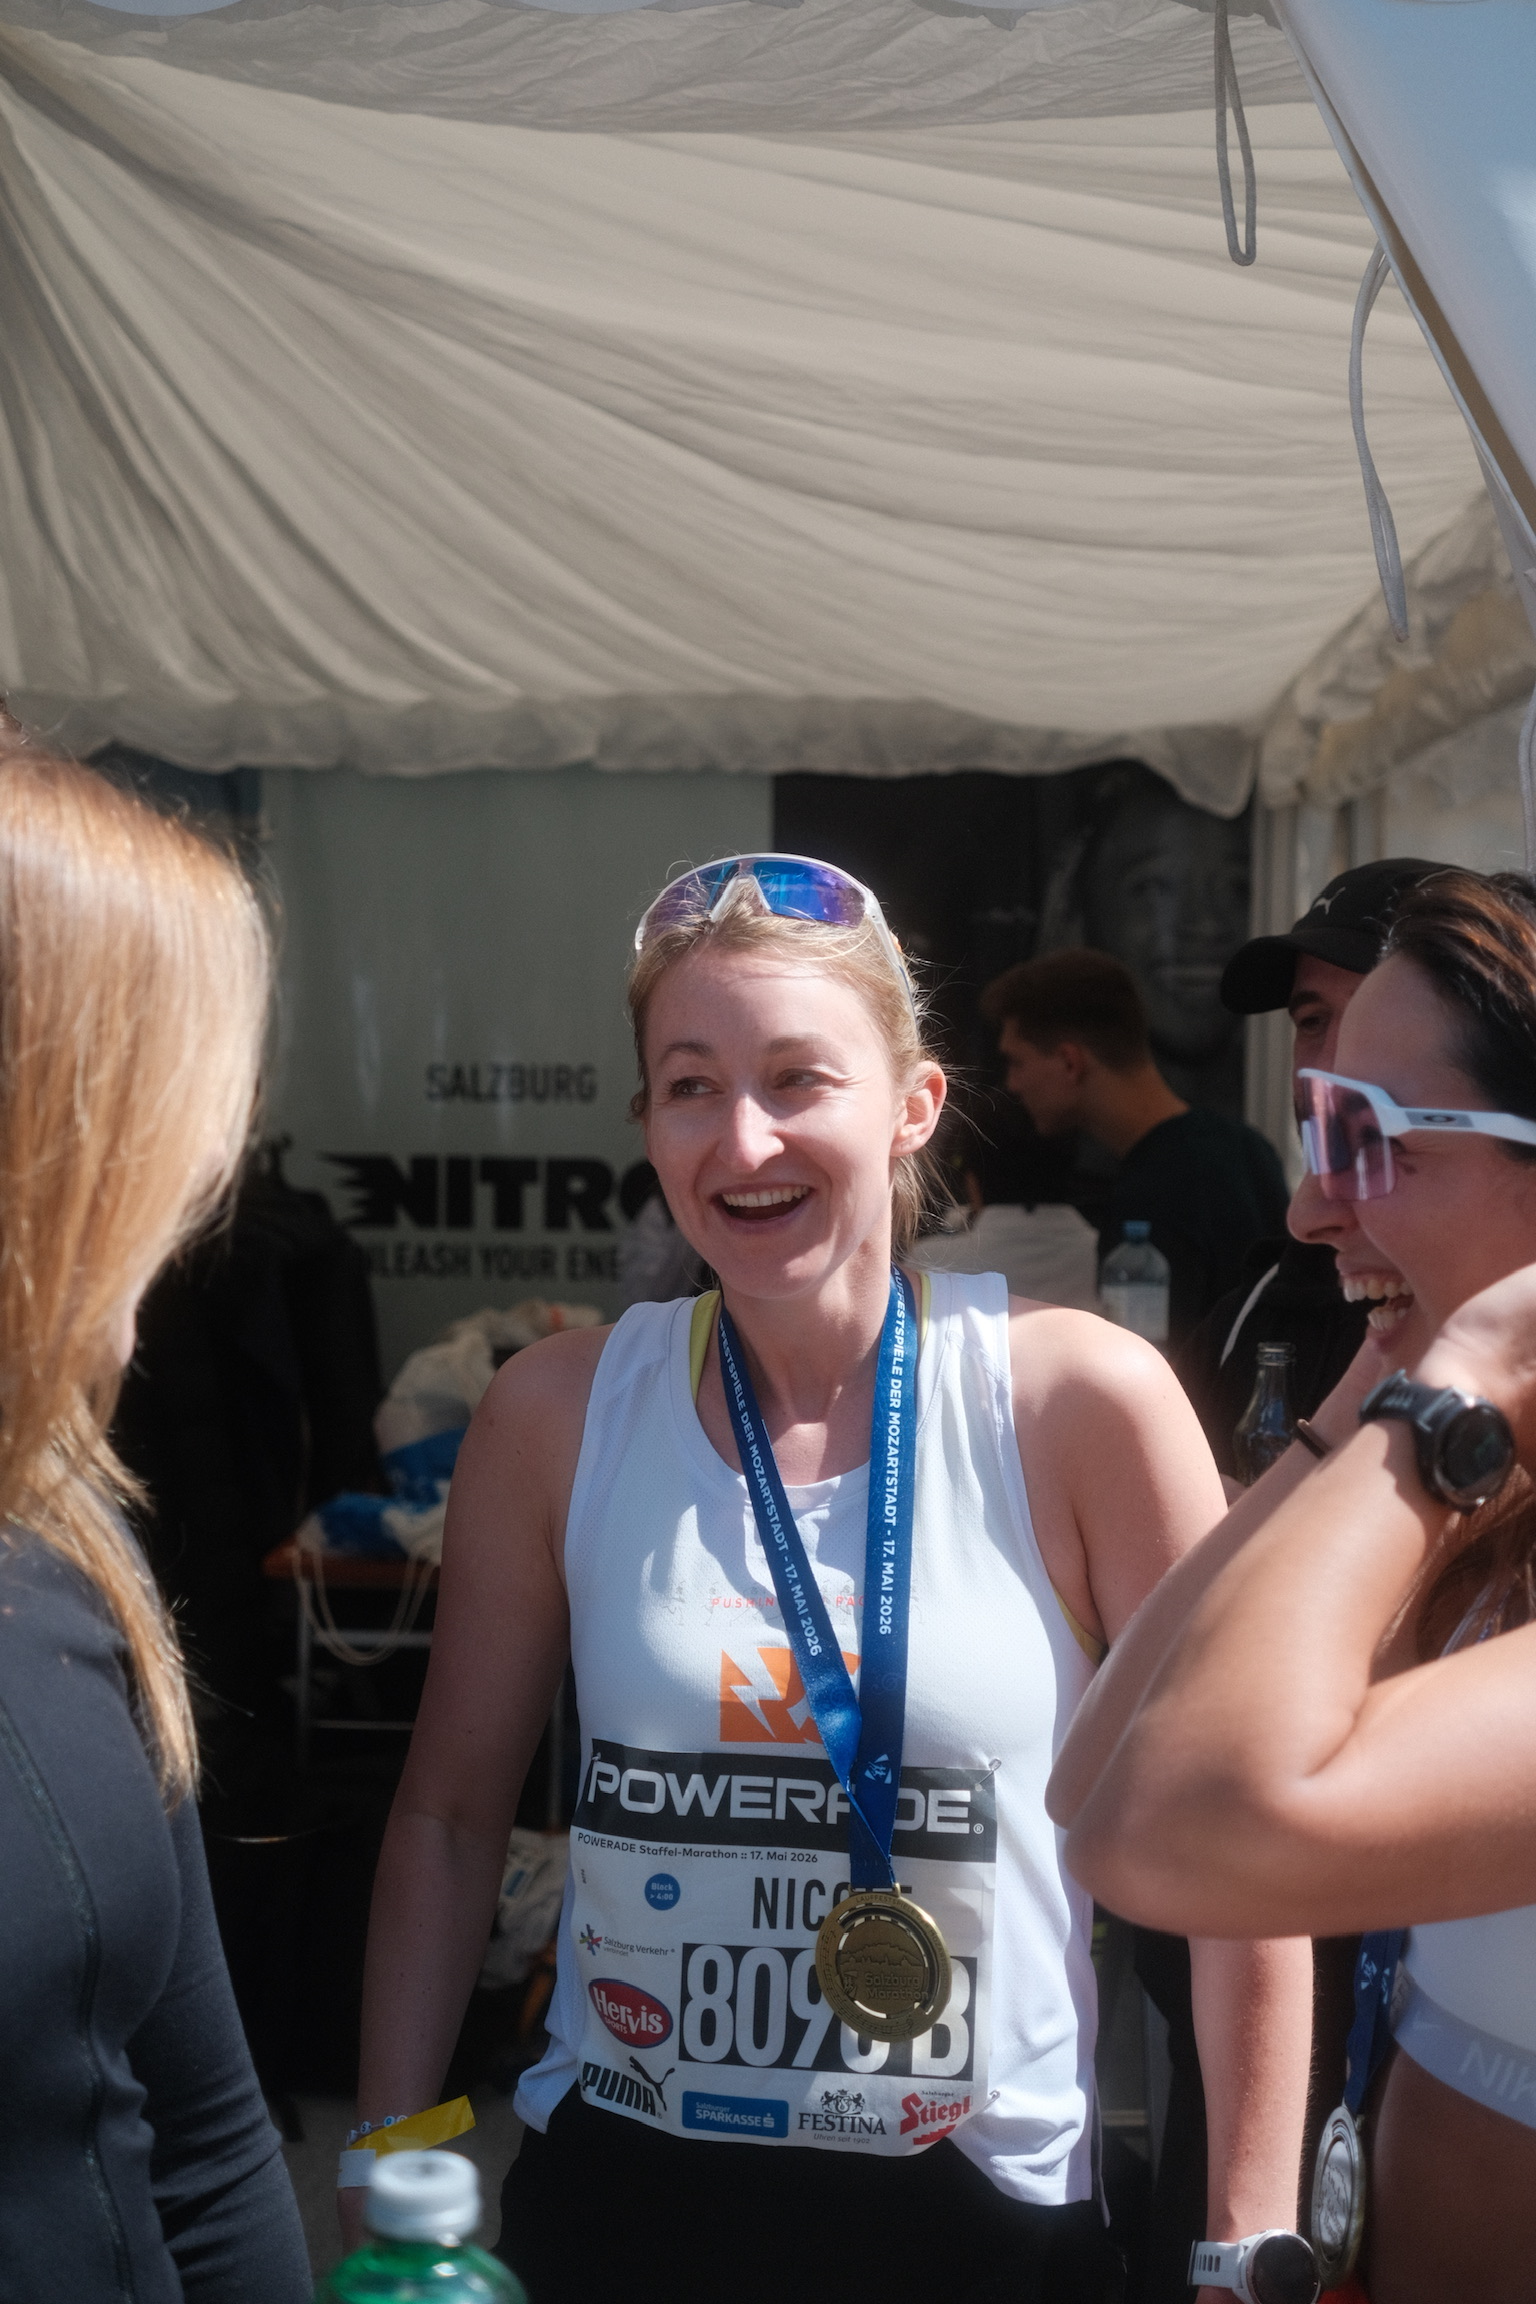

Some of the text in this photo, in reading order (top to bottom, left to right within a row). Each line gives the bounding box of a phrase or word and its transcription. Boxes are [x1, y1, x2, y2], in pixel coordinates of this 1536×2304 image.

[426, 1062, 598, 1105] SALZBURG
[479, 1243, 557, 1281] YOUR
[889, 1378, 902, 1409] DER
[884, 1411, 901, 1527] MOZARTSTADT
[741, 1413, 754, 1443] DER
[749, 1442, 789, 1551] MOZARTSTADT
[784, 1564, 798, 1585] 17.
[791, 1584, 808, 1616] MAI
[801, 1616, 822, 1657] 2026
[883, 1540, 895, 1558] 17.
[882, 1562, 894, 1592] MAI
[711, 1596, 775, 1609] PUSHIN
[879, 1595, 893, 1635] 2026
[577, 1833, 636, 1853] POWERADE
[639, 1845, 738, 1860] Staffel-Marathon
[750, 1850, 764, 1860] 17.
[766, 1851, 787, 1861] Mai
[790, 1852, 819, 1863] 2026
[651, 1882, 674, 1892] Block
[604, 1935, 669, 1957] Salzburg Verkehr
[592, 1985, 664, 2035] Hervis
[582, 2061, 657, 2117] PUMA
[695, 2101, 731, 2113] Salzburger
[695, 2108, 761, 2127] SPARKASSE
[900, 2092, 972, 2136] Stiegl
[798, 2112, 887, 2137] FESTINA
[813, 2133, 871, 2145] Uhren seit 1902
